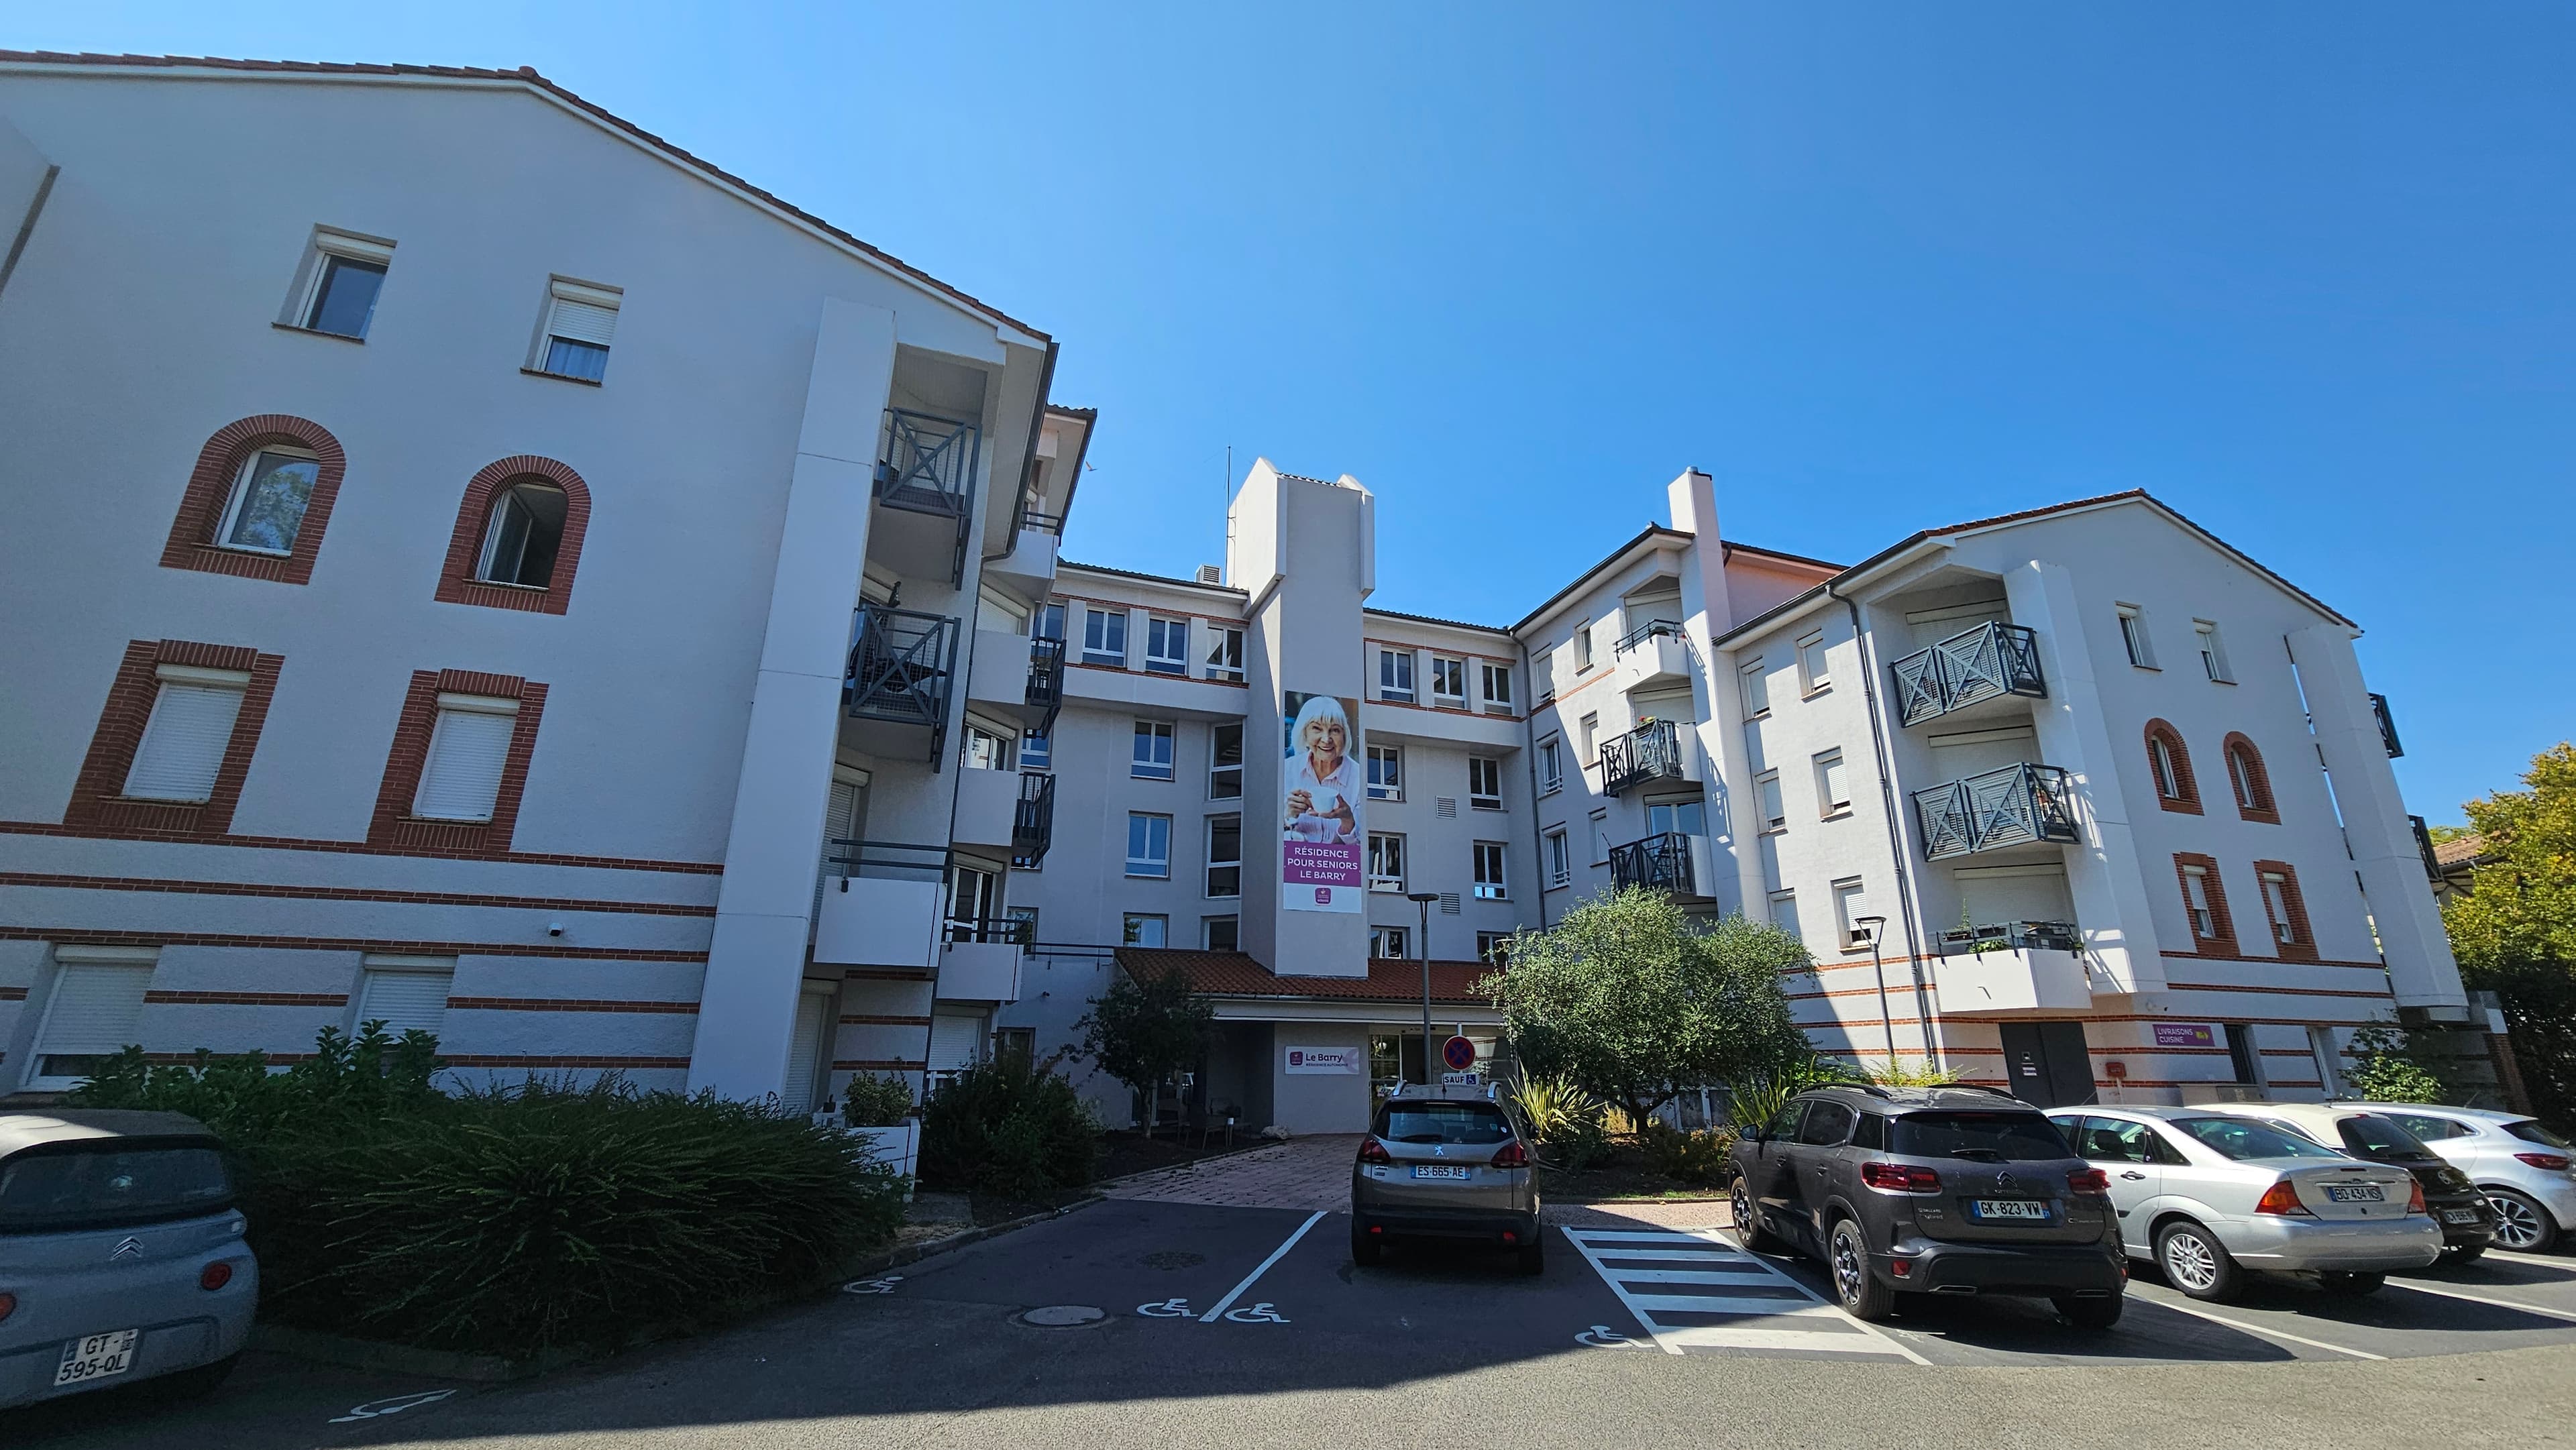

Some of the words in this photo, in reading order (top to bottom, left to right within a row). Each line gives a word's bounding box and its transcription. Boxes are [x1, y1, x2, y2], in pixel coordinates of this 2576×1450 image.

[1295, 846, 1349, 858] RÉSIDENCE
[1287, 858, 1315, 867] POUR
[1317, 860, 1358, 870] SENIORS
[1300, 870, 1312, 879] LE
[1314, 872, 1346, 881] BARRY
[2157, 1027, 2193, 1036] LIVRAISONS
[1305, 1053, 1316, 1061] Le
[1318, 1054, 1342, 1063] Barry
[1444, 1076, 1464, 1084] SAUF
[60, 1353, 125, 1382] 595-QL
